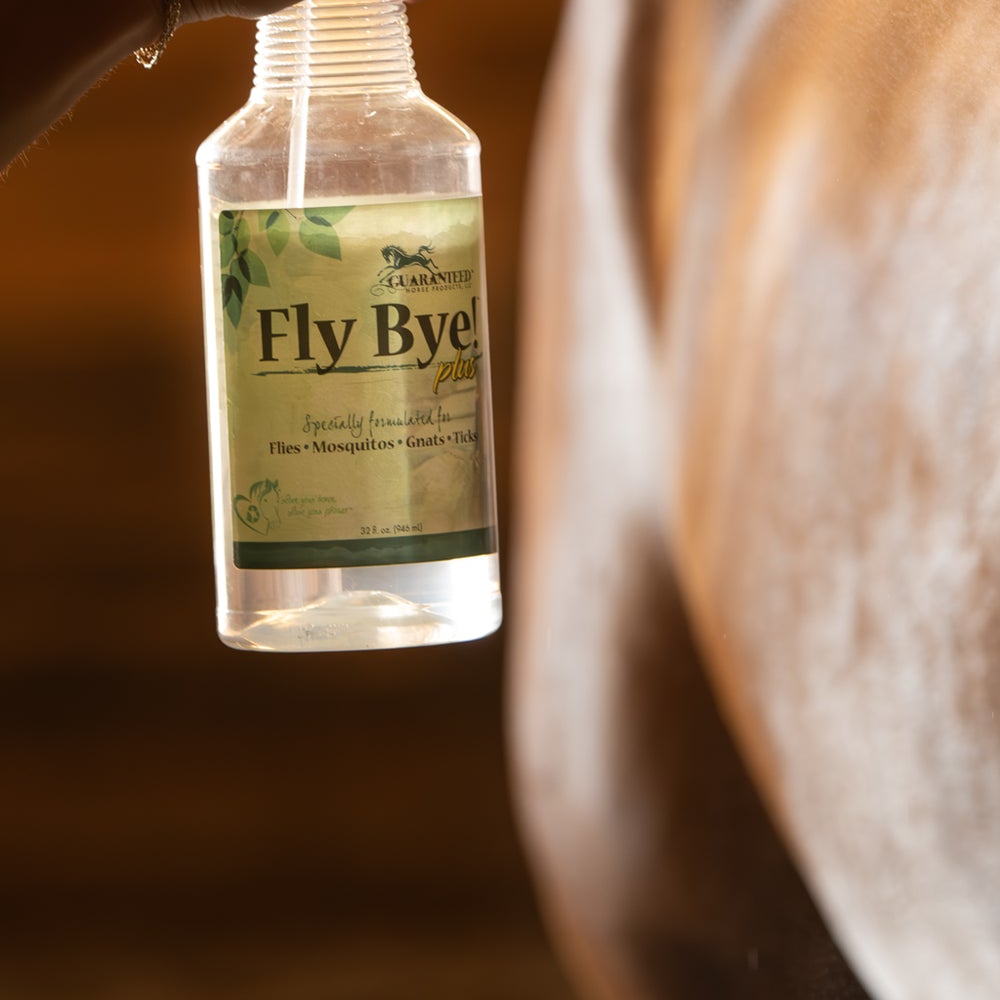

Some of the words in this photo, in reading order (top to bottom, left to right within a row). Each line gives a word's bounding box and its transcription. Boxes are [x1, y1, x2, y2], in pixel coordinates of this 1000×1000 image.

[388, 270, 472, 288] GUARANTEED
[256, 302, 358, 376] Fly
[370, 296, 478, 370] Bye!
[432, 347, 477, 395] plus
[302, 413, 364, 438] Specially
[368, 409, 435, 437] formulated
[437, 405, 451, 432] for
[269, 441, 301, 455] Flies
[312, 437, 395, 455] Mosquitos
[406, 433, 446, 449] Gnats
[453, 428, 479, 445] Ticks
[360, 526, 371, 535] 32
